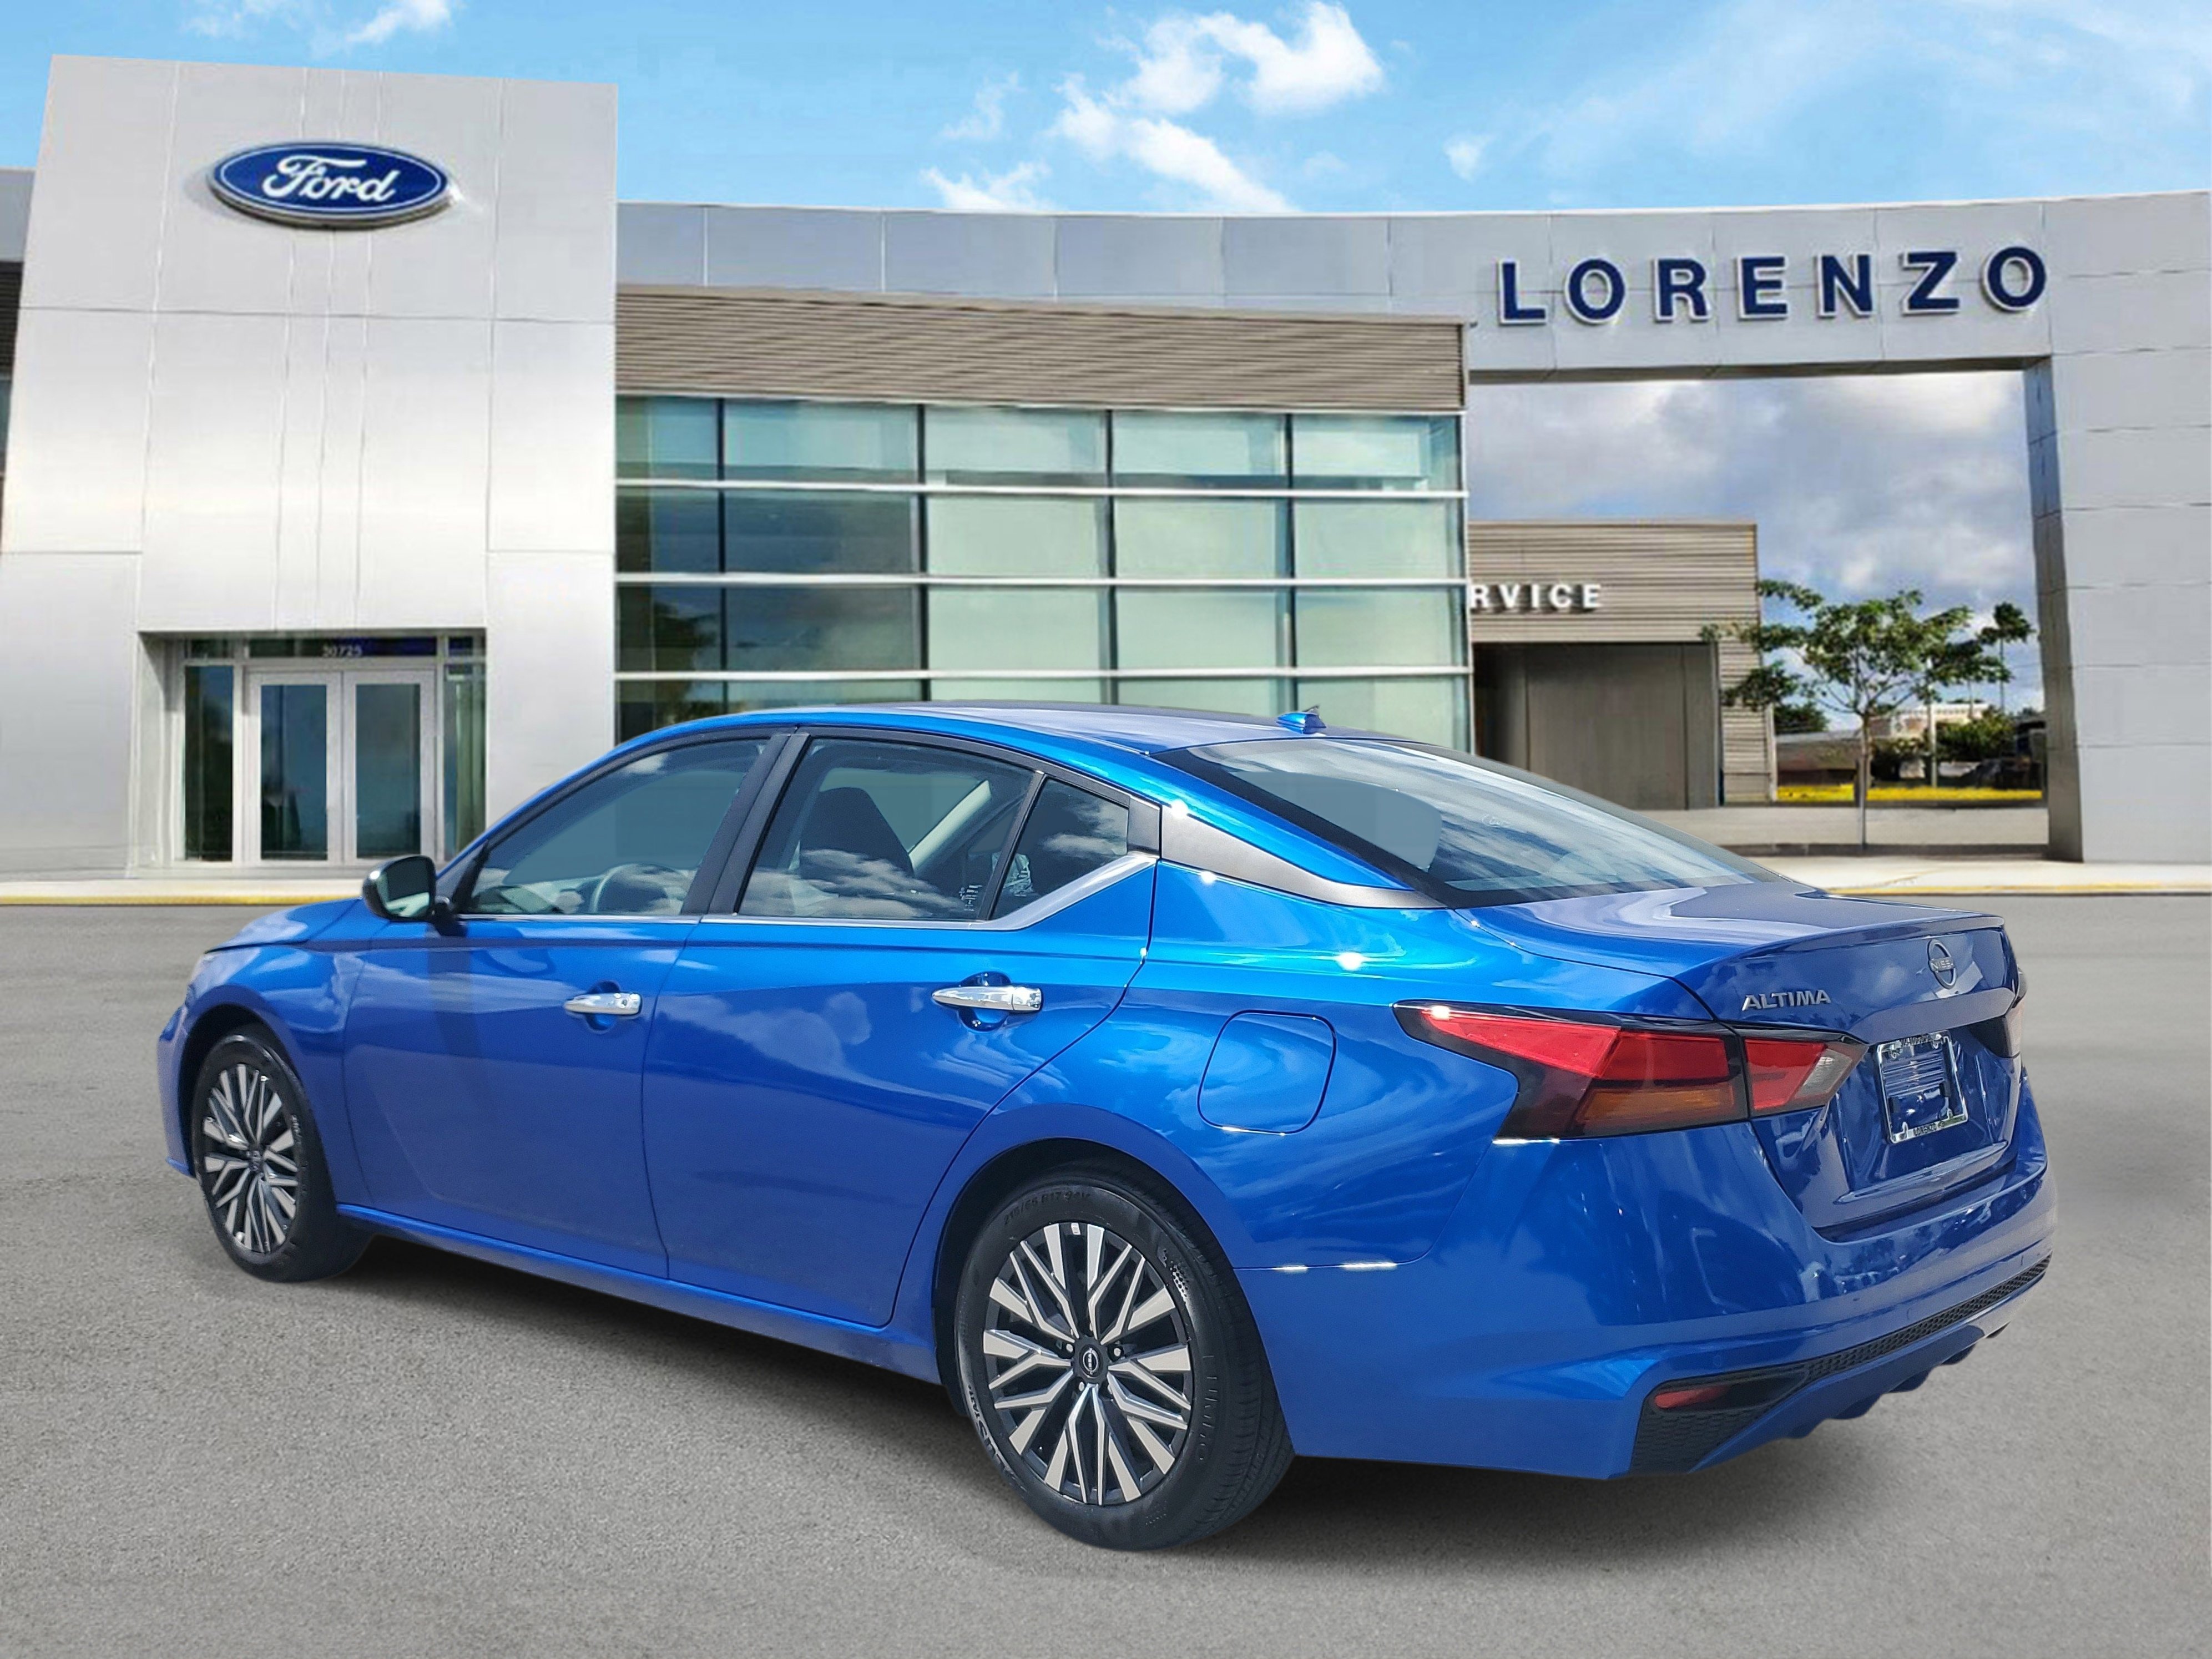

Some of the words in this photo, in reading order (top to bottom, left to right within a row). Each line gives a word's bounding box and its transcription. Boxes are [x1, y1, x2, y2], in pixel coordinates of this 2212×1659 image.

[262, 155, 401, 202] Ford
[1498, 246, 2047, 324] LORENZO
[1471, 584, 1602, 609] RVICE
[1741, 989, 1831, 1011] ALTIMA
